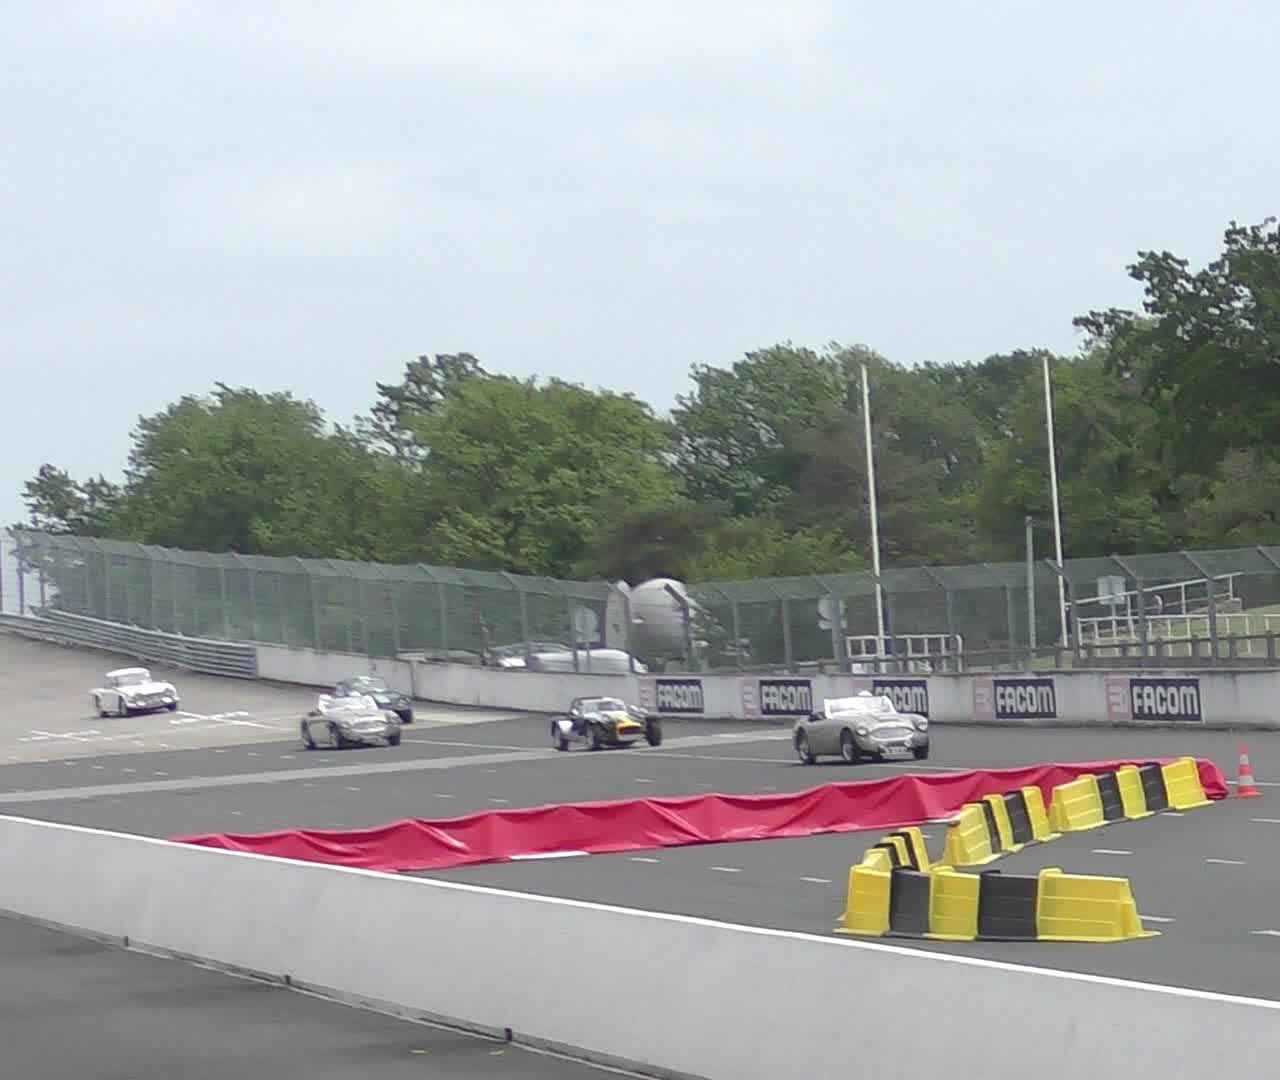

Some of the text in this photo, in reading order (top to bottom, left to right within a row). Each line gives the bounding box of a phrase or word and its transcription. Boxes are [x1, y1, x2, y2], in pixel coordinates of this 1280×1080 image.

[657, 684, 701, 710] FACOM
[761, 684, 811, 711] FACOM
[996, 685, 1055, 713] FACOM
[1132, 685, 1200, 715] FACOM
